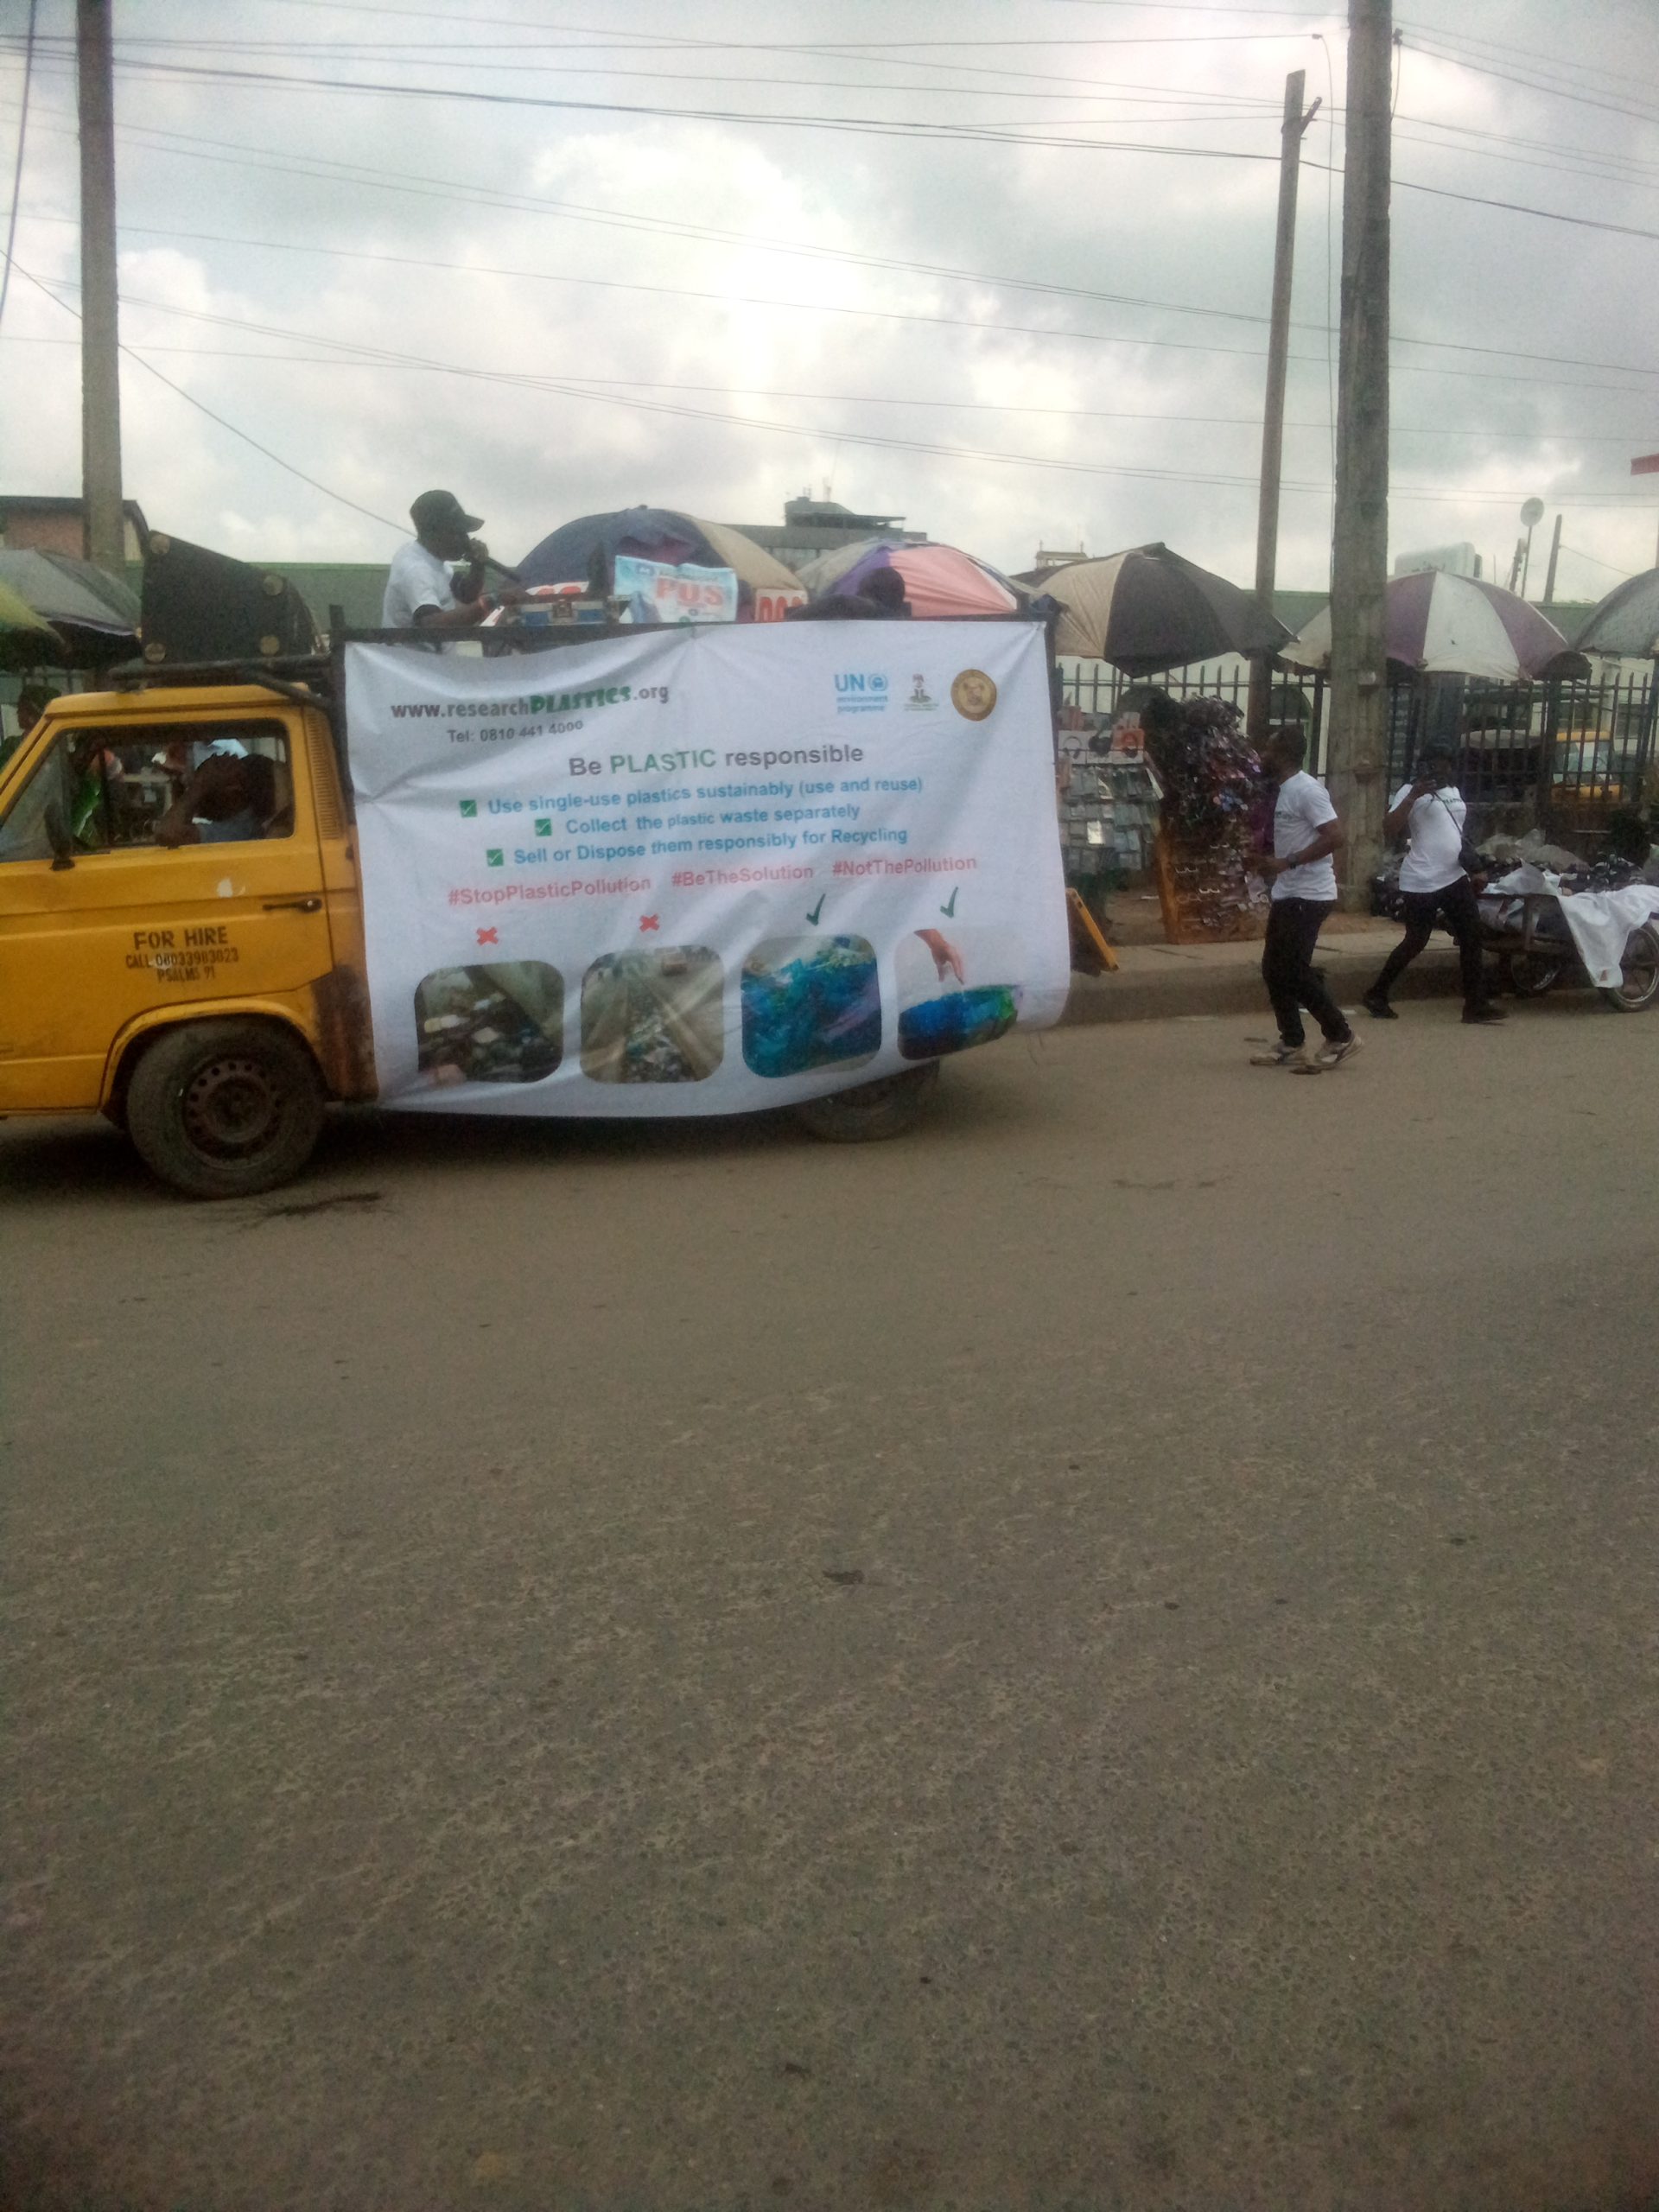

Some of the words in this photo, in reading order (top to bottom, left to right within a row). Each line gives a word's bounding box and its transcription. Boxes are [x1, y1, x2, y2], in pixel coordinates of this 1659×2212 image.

[835, 674, 865, 691] UN
[391, 686, 668, 718] www.researchPLASTICS.org
[447, 728, 474, 742] Tel:
[480, 727, 515, 741] 0810
[518, 724, 543, 738] 441
[549, 719, 584, 734] 4000
[569, 757, 602, 776] Be
[609, 748, 716, 774] PLASTIC
[725, 744, 864, 770] responsible
[488, 798, 523, 815] Use
[529, 793, 621, 812] single-use
[626, 786, 691, 809] plastics
[696, 780, 794, 799] sustainably
[798, 779, 835, 798] (use
[840, 778, 870, 793] and
[874, 776, 923, 793] reuse)
[566, 818, 627, 835] Collect
[636, 815, 663, 830] the
[667, 810, 715, 827] plastic
[719, 808, 768, 823] waste
[773, 804, 861, 824] separately
[514, 849, 548, 865] Sell
[553, 849, 571, 861] or
[577, 843, 645, 862] Dispose
[651, 838, 693, 855] them
[698, 831, 798, 853] responsibly
[802, 829, 826, 844] for
[831, 827, 909, 845] Recycling
[449, 876, 651, 906] #StopPlasticPollution
[671, 865, 814, 887] #BeTheSolution
[832, 856, 977, 879] #NotThePollution
[133, 931, 175, 950] FOR
[184, 925, 229, 947] HIRE
[125, 953, 152, 969] CALL
